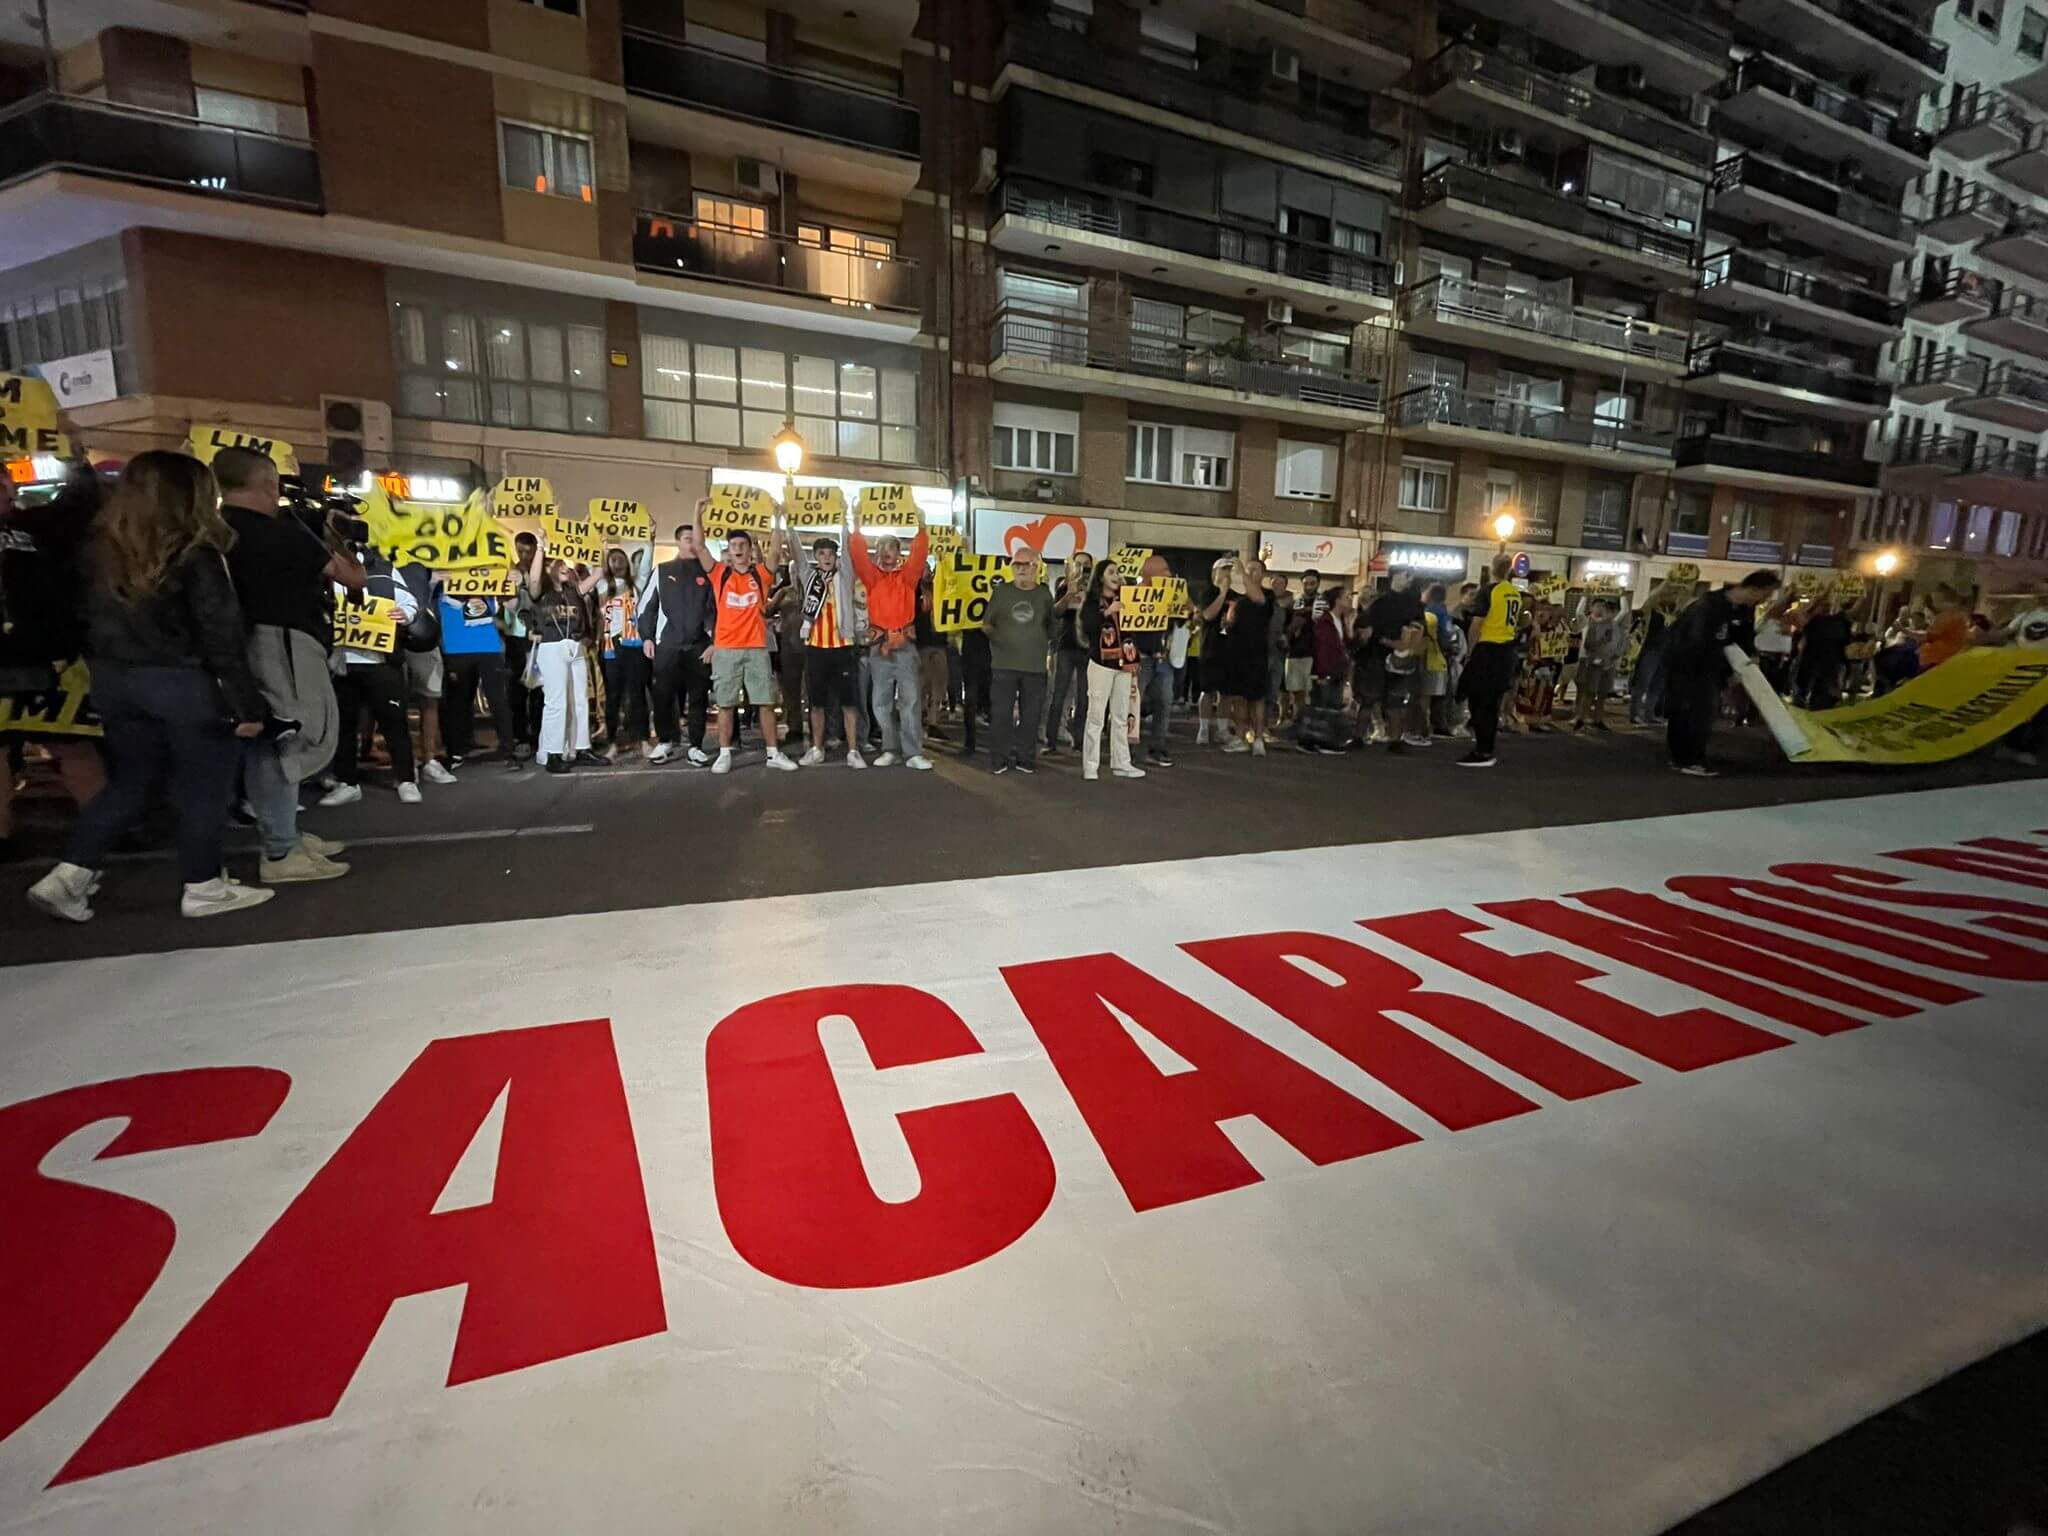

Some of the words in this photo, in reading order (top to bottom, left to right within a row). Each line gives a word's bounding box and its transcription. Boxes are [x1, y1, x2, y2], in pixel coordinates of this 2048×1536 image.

[0, 423, 58, 451] ME
[211, 430, 273, 456] LIM
[504, 479, 540, 492] LIM
[722, 484, 760, 500] LIM
[515, 493, 534, 502] GO
[795, 487, 829, 500] LIM
[869, 486, 904, 500] LIM
[497, 503, 555, 516] HOME
[601, 500, 637, 513] LIM
[731, 499, 750, 510] GO
[804, 502, 822, 511] GO
[878, 502, 896, 511] GO
[610, 513, 629, 522] GO
[709, 508, 771, 528] HOME
[786, 512, 841, 525] HOME
[862, 512, 916, 525] HOME
[555, 519, 589, 536] LIM
[931, 527, 956, 536] LIM
[565, 535, 583, 544] GO
[548, 542, 600, 562] HOME
[1118, 548, 1144, 557] LIM
[1390, 550, 1408, 566] LA
[1408, 551, 1464, 570] PAGODA
[469, 567, 490, 577] GO
[447, 579, 513, 593] HOME
[1132, 588, 1164, 602] LIM
[941, 597, 990, 625] HO
[1139, 603, 1155, 613] GO
[1121, 615, 1167, 628] HOME
